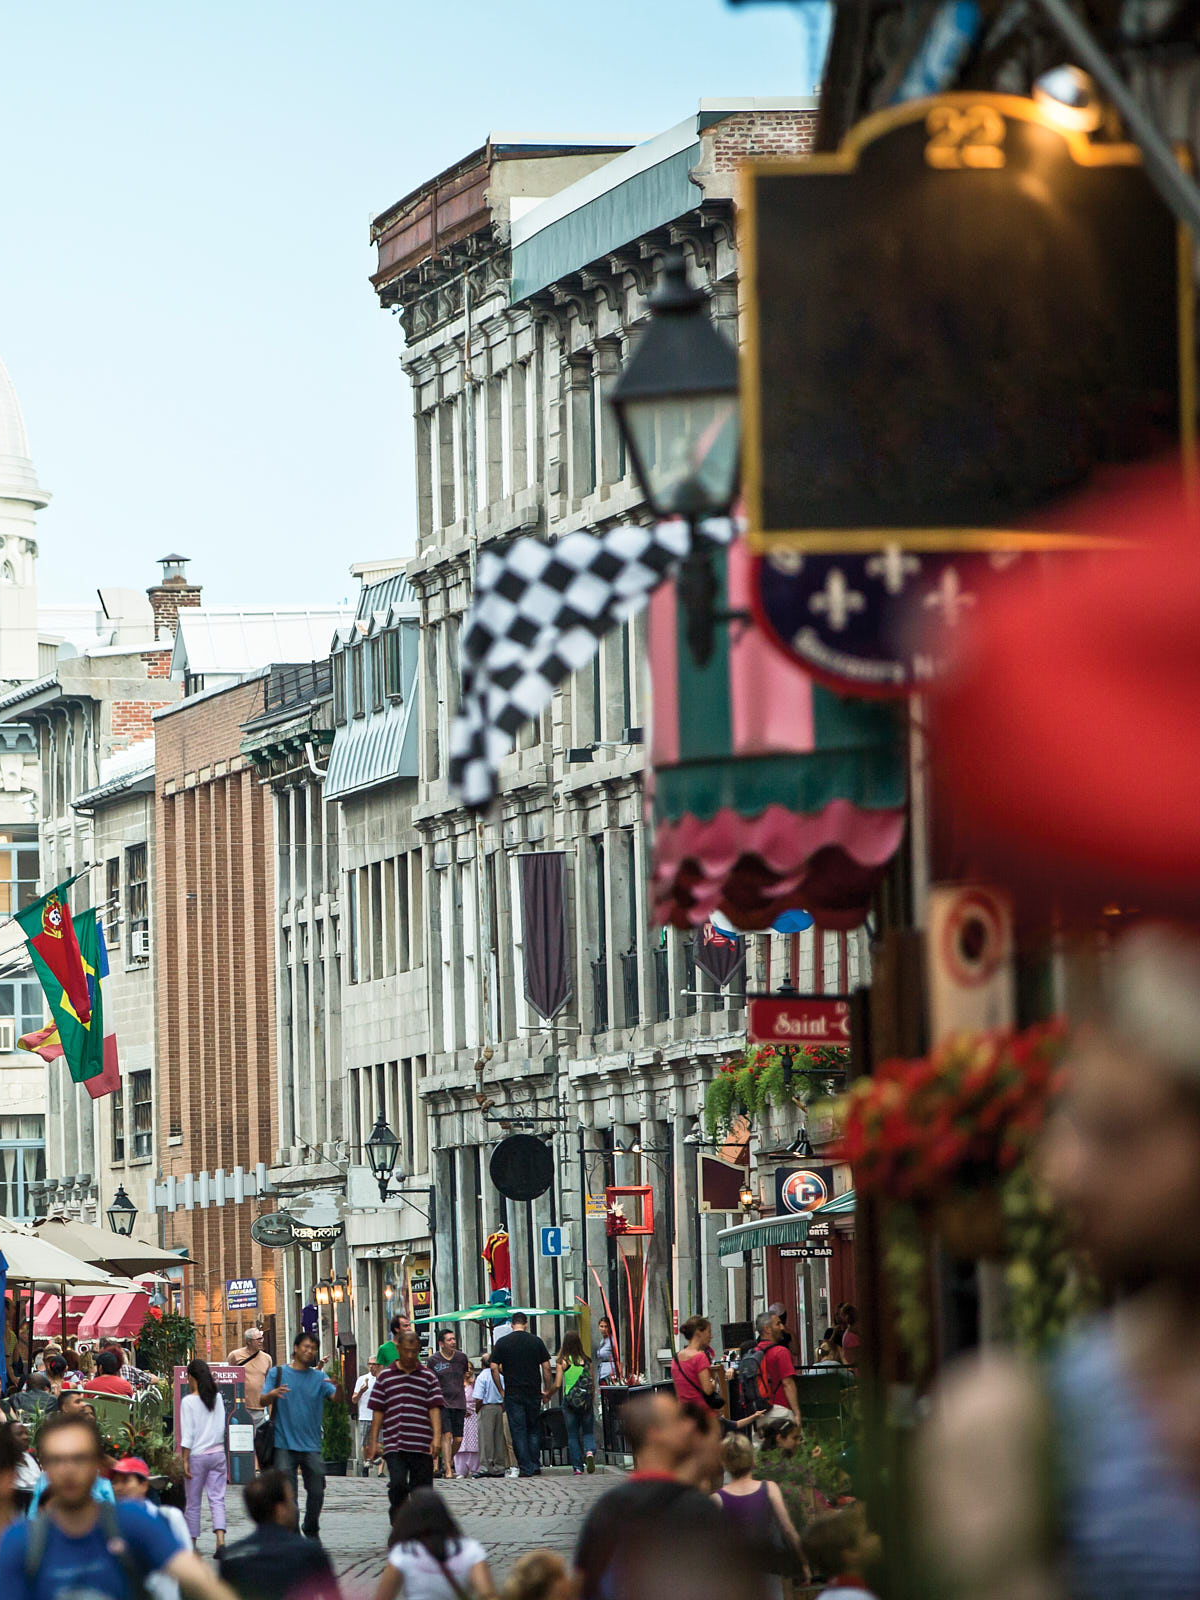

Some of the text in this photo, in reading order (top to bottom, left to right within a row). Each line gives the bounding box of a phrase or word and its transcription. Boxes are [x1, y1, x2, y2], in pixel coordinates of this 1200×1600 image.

[925, 105, 1005, 169] 22
[780, 1248, 832, 1257] RESTO BAR
[230, 1280, 254, 1290] ATM
